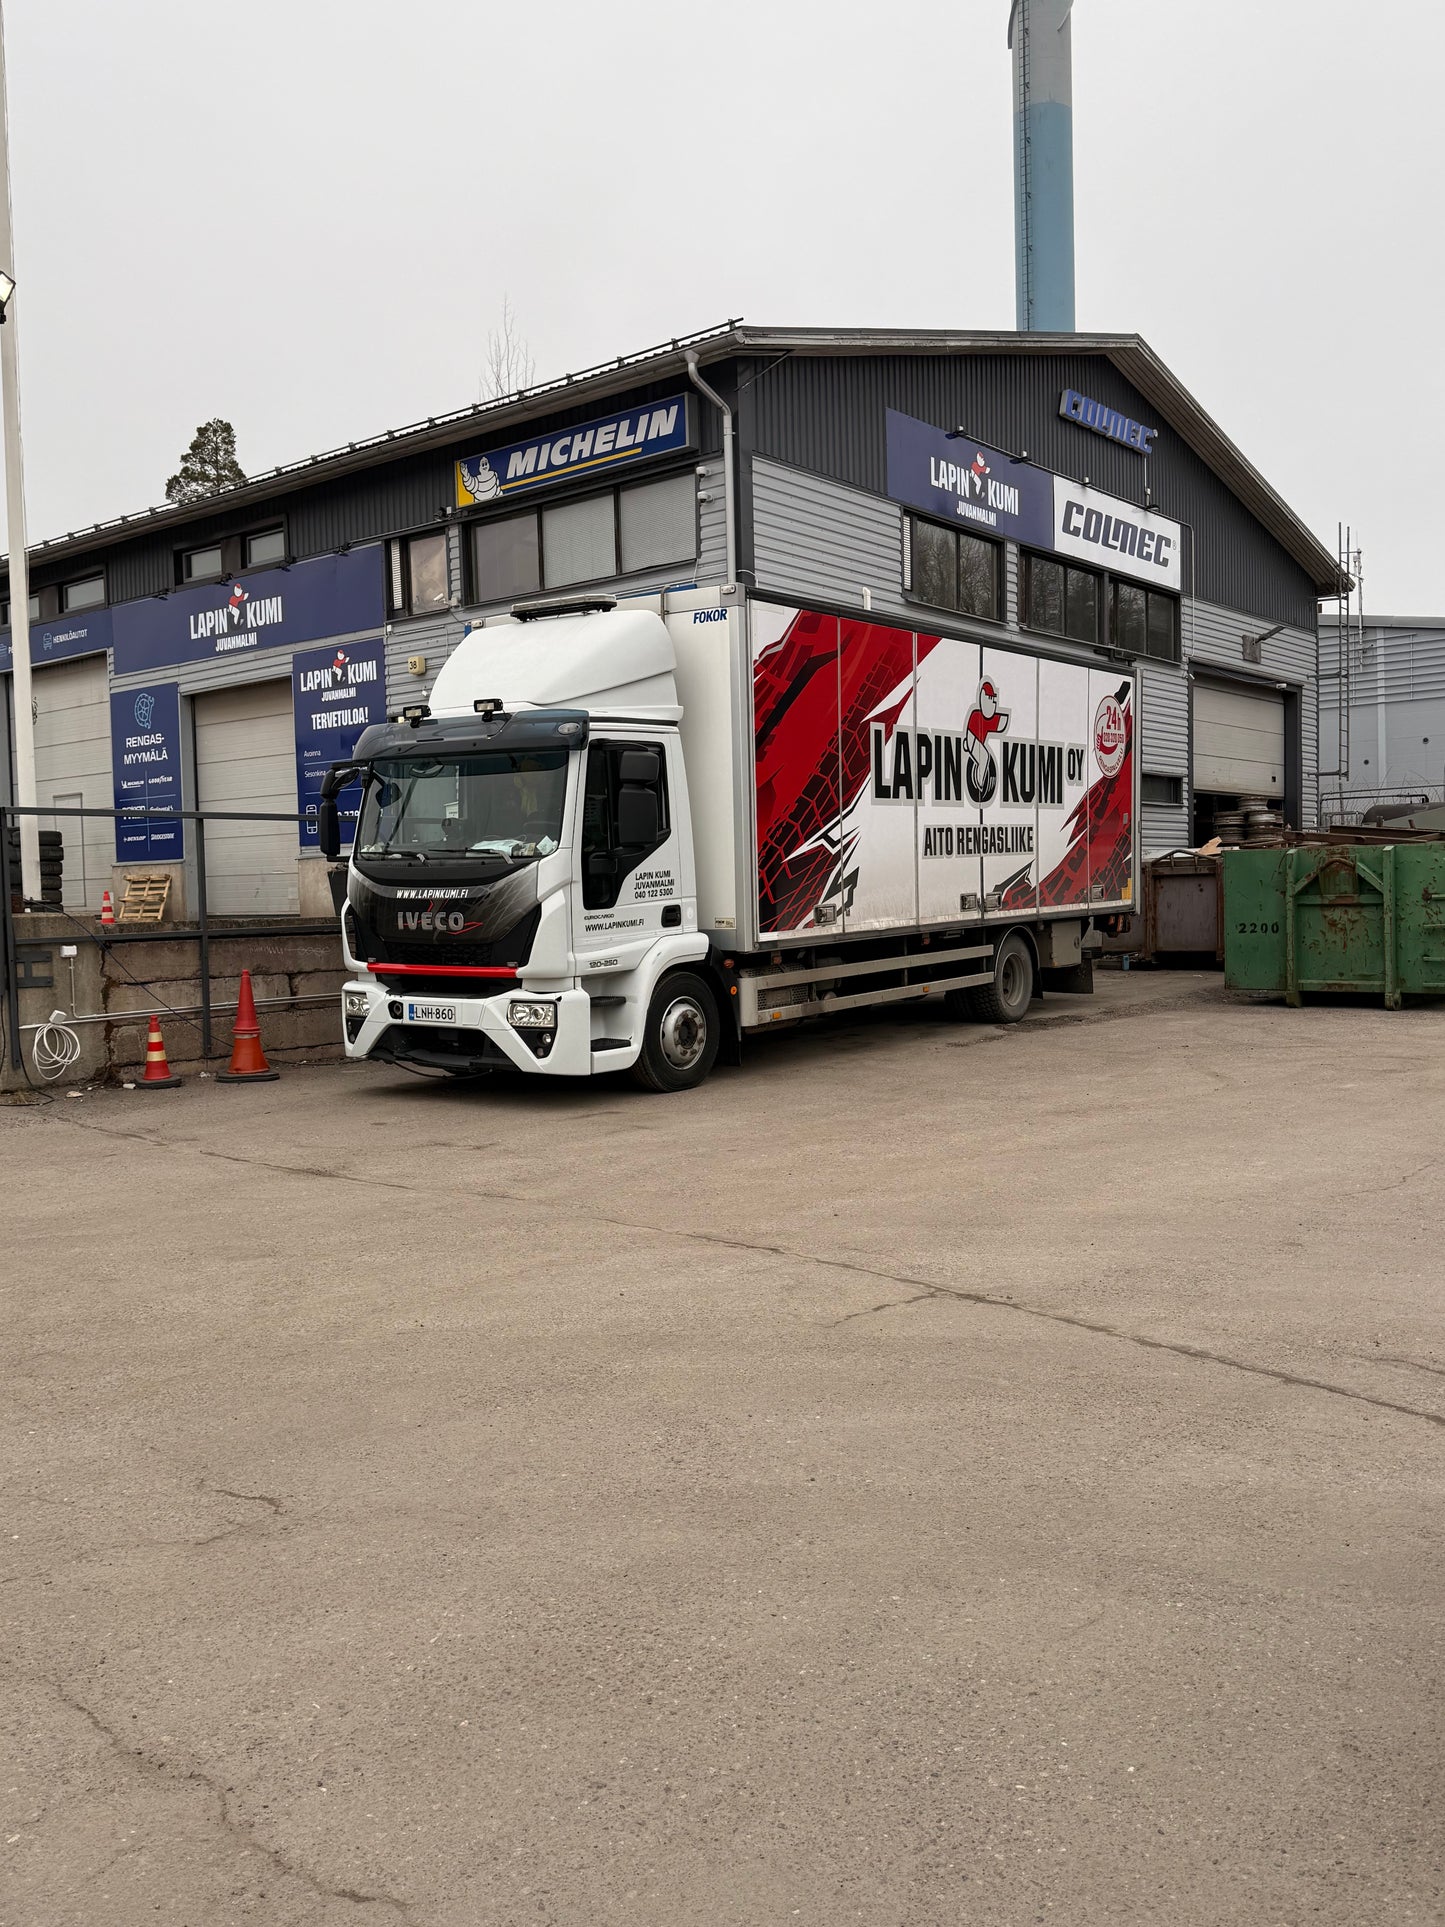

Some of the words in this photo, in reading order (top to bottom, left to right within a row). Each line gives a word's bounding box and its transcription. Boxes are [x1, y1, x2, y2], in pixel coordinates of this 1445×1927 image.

[1060, 389, 1153, 455] COLMEC
[506, 405, 679, 479] MICHELIN
[930, 456, 970, 498] LAPIN
[987, 478, 1019, 516] KUMI
[956, 500, 997, 527] JUVANMALMI
[1062, 500, 1172, 568] COLMEC
[189, 608, 228, 640] LAPIN
[246, 596, 283, 628] KUMI
[693, 609, 728, 624] FOKOR
[53, 629, 88, 644] HENKILÖAUTOT
[215, 632, 258, 652] JUVANMALMI
[300, 668, 333, 692] LAPIN
[347, 660, 377, 684] KUMI
[321, 687, 357, 702] JUVANMALMI
[311, 707, 369, 730] TERVETULOA!
[125, 733, 165, 749] RENGAS-
[123, 747, 168, 765] MYYMÄLÄ
[874, 729, 962, 800] LAPIN
[1003, 741, 1063, 804] KUMI
[1067, 748, 1084, 781] OY
[923, 827, 954, 857] AITO
[956, 826, 1034, 855] RENGASLIIKE
[634, 879, 675, 890] JUVANMALMI
[635, 872, 654, 881] LAPIN
[655, 870, 671, 879] KUMI
[396, 889, 469, 899] WWW.LAPINKUMI.FI
[634, 891, 647, 899] 040
[648, 889, 658, 898] 122
[659, 888, 674, 897] 5300
[397, 911, 464, 931] IVECO
[585, 919, 645, 932] WWW.LAPINKUMI.FI
[1238, 922, 1280, 934] 2200
[589, 959, 618, 969] 120-250
[415, 1006, 453, 1020] LNH-860
